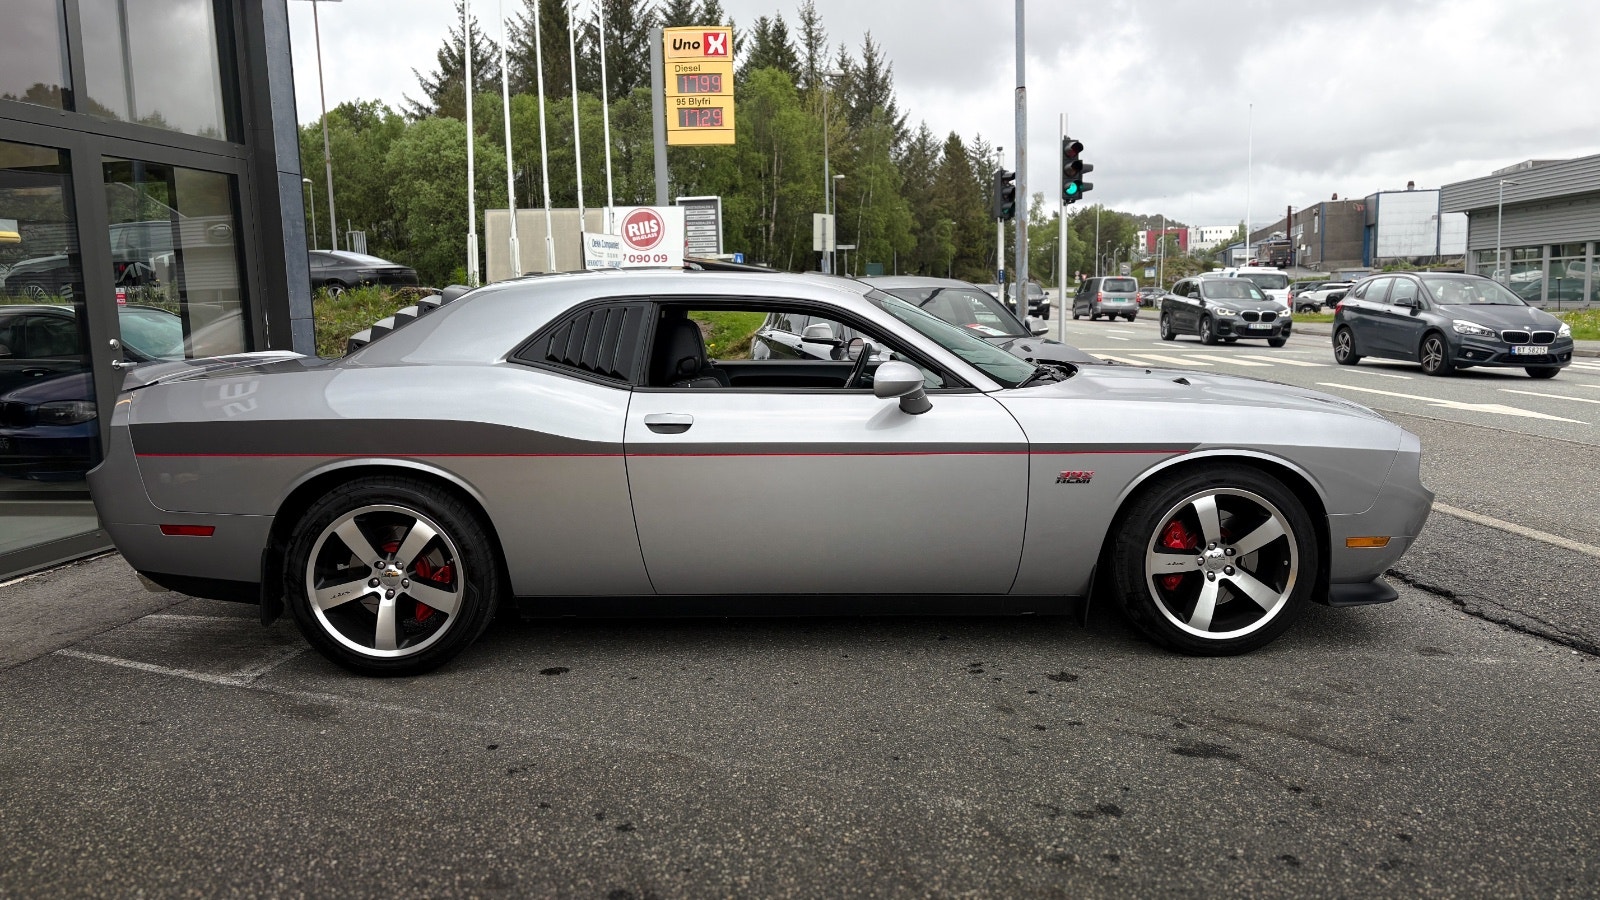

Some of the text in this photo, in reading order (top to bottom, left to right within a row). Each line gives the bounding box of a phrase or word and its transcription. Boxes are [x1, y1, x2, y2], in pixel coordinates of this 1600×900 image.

[672, 34, 725, 54] Uno X
[674, 64, 701, 73] Diesel
[676, 97, 711, 107] 95 Blyfri
[628, 220, 658, 236] RIIS
[628, 254, 651, 263] 090
[653, 253, 668, 263] 09
[1528, 346, 1546, 354] 58215
